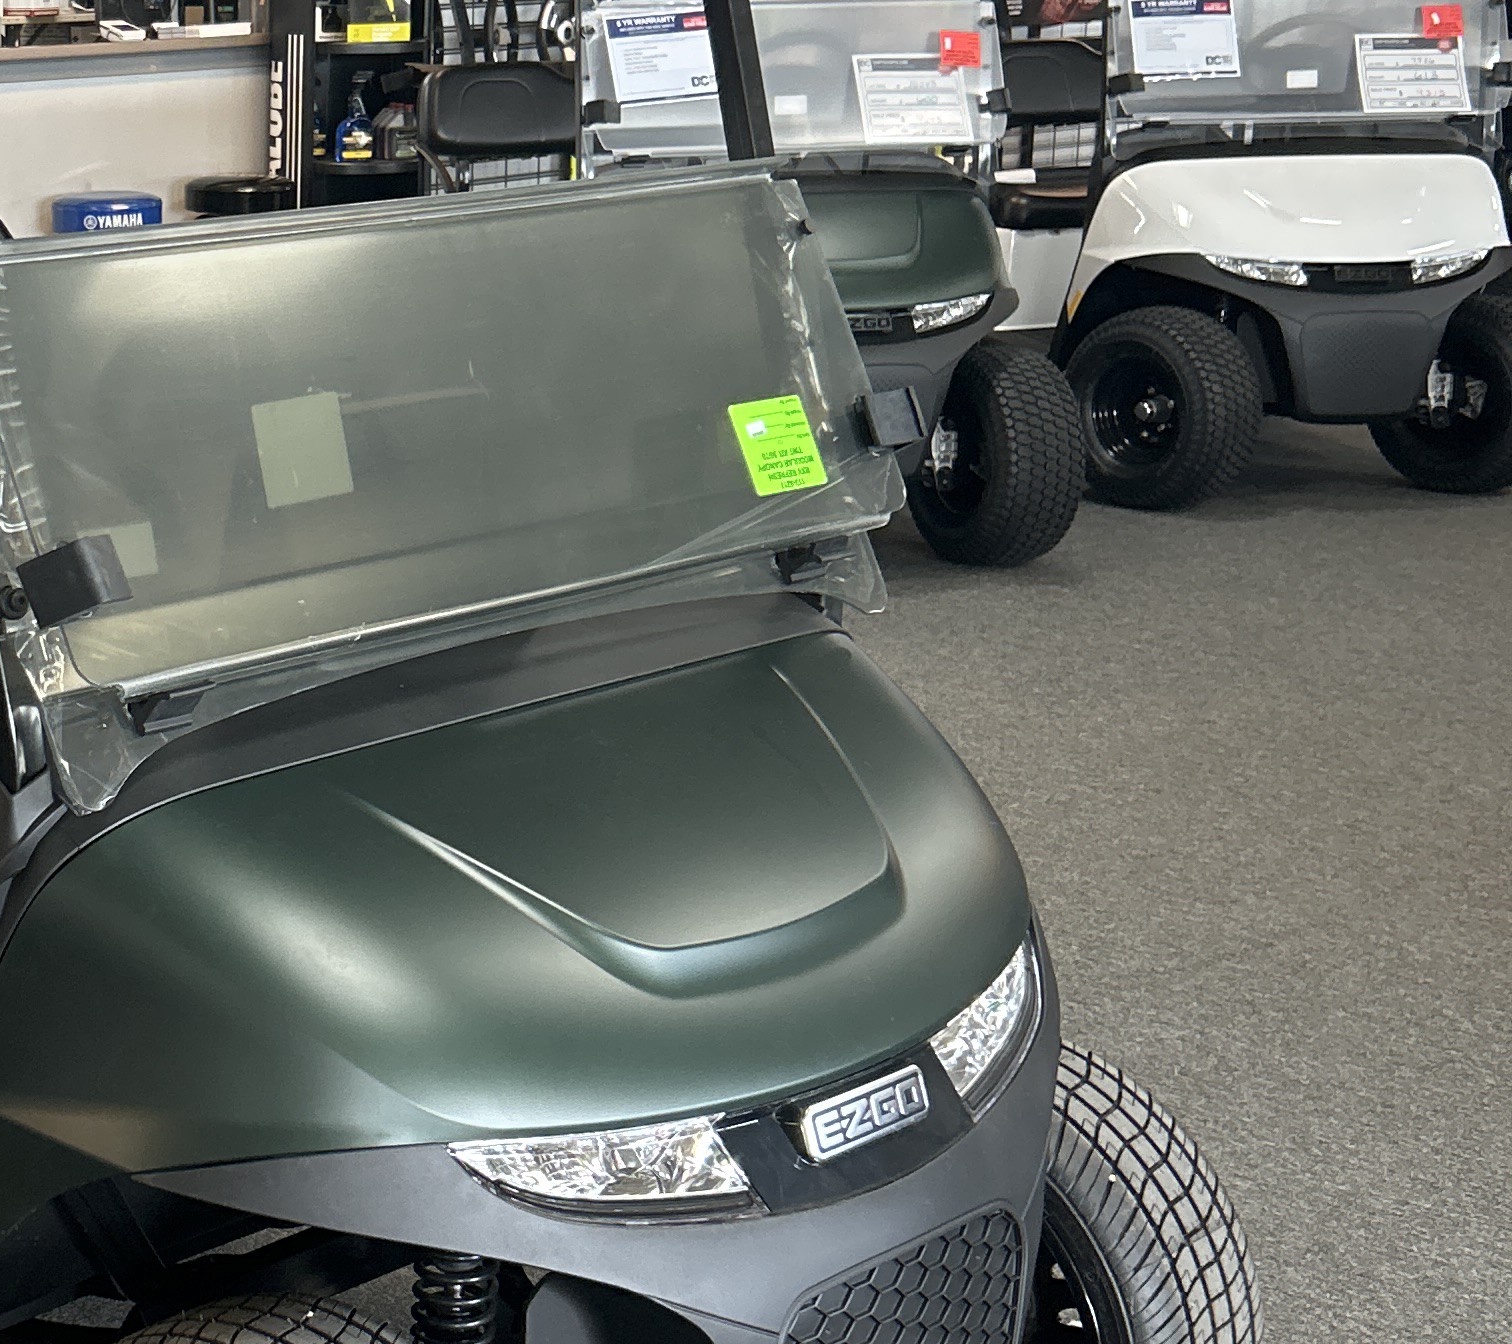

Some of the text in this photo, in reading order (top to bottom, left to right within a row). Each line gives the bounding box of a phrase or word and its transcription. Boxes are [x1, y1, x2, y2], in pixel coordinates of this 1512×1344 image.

[621, 18, 633, 27] YR
[634, 16, 676, 26] WARRANTY
[269, 60, 283, 178] ALUBE
[97, 212, 143, 229] YAMAHA
[848, 316, 891, 330] ZGO
[814, 1076, 926, 1150] EZGO
